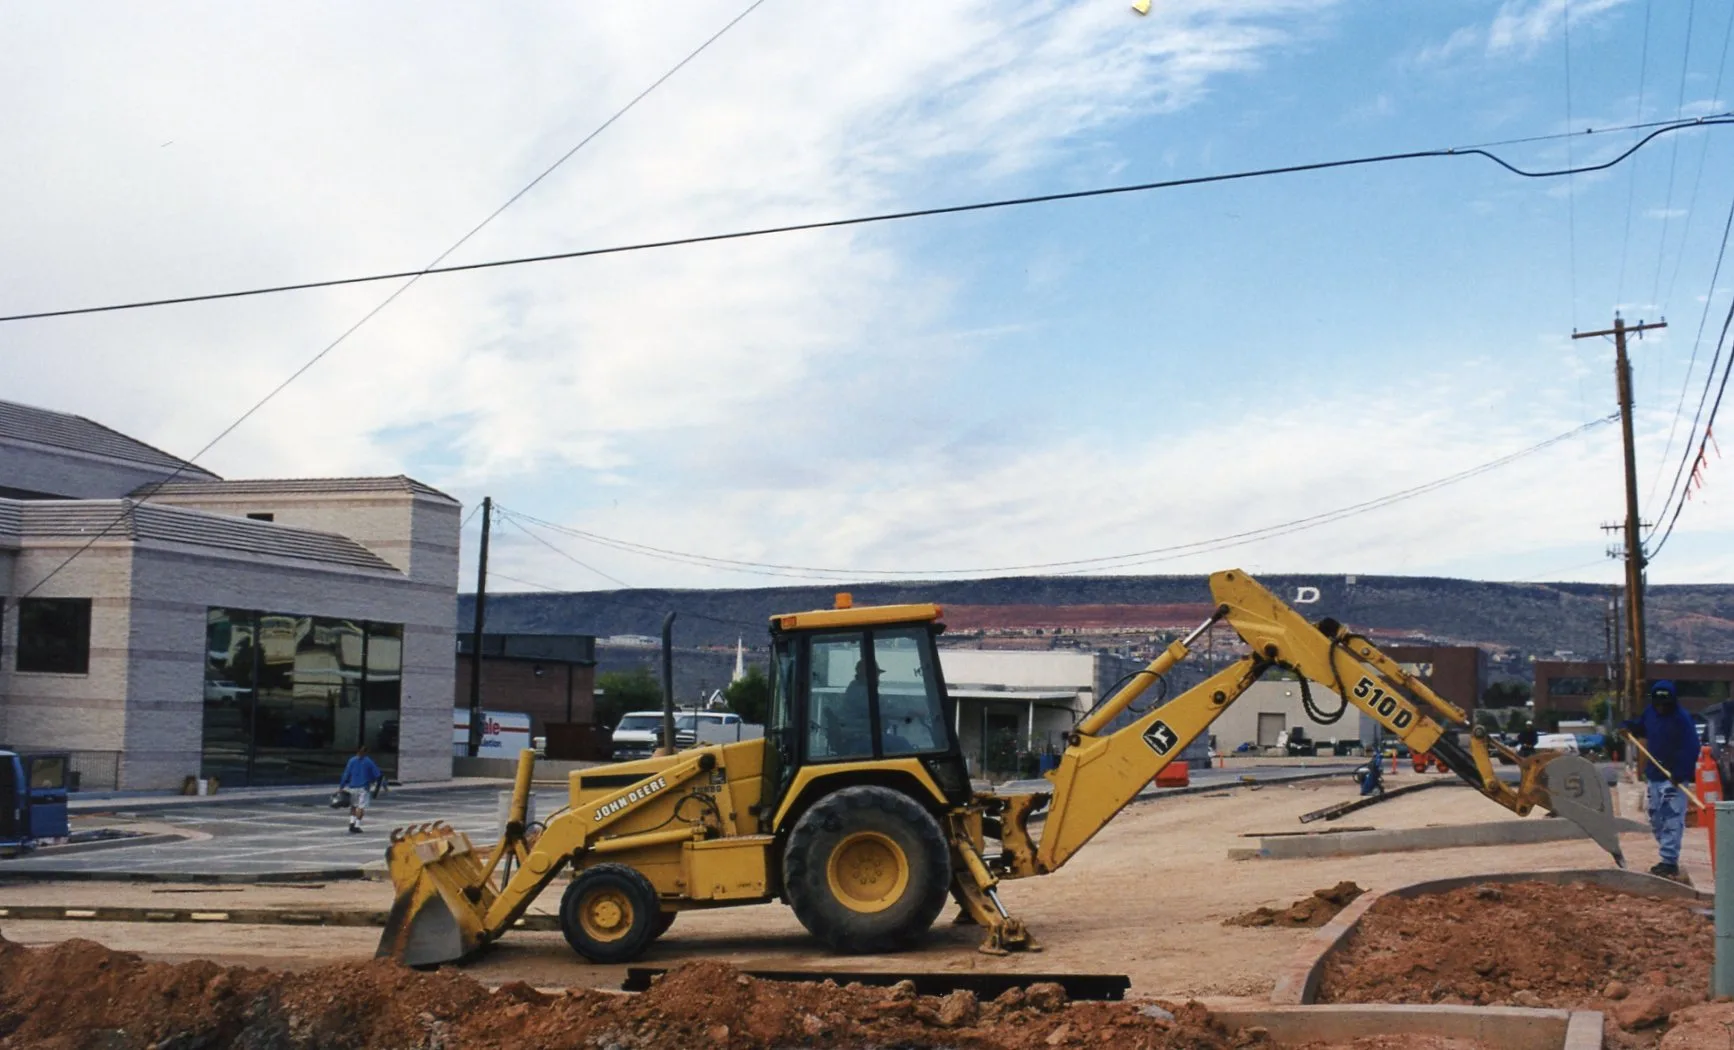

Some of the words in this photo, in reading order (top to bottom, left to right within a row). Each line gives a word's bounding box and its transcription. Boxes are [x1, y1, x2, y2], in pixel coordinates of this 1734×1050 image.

[1294, 586, 1320, 603] D
[1353, 676, 1413, 729] 510D
[594, 796, 629, 821] JOHN
[627, 776, 667, 803] DEERE
